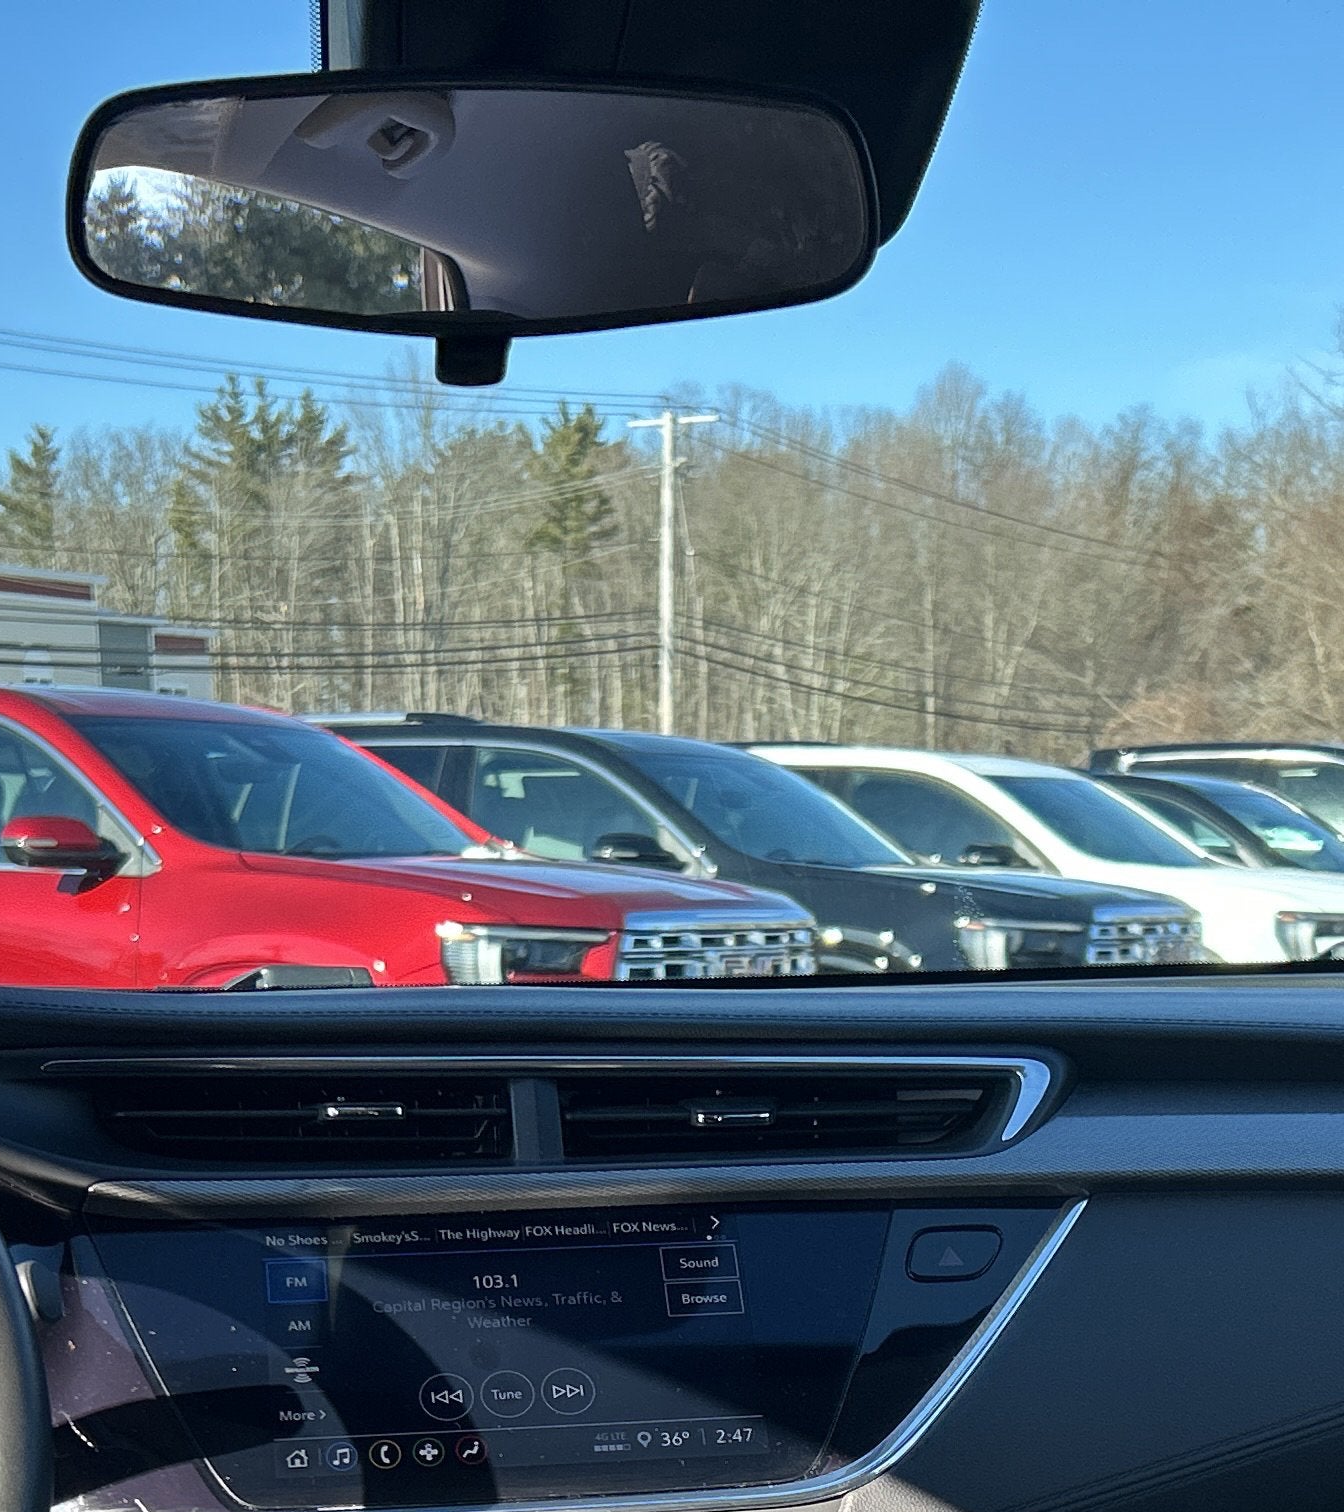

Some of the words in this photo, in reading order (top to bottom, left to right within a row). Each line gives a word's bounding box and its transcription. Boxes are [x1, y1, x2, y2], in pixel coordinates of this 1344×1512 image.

[438, 1228, 463, 1241] The
[466, 1226, 521, 1242] Highway
[524, 1224, 553, 1237] FOX
[612, 1221, 641, 1234] FOX
[265, 1235, 285, 1247] No
[288, 1234, 328, 1247] Shoes
[678, 1256, 720, 1269] Sound
[285, 1276, 308, 1288] FM
[472, 1273, 520, 1290] 103.1
[372, 1296, 427, 1315] Capital
[430, 1295, 498, 1315] Region's
[500, 1294, 549, 1309] News,
[552, 1291, 607, 1306] Traffic,
[611, 1290, 623, 1304] &
[680, 1292, 728, 1305] Browse
[287, 1319, 312, 1332] AM
[466, 1315, 533, 1330] Weather
[490, 1388, 524, 1401] Tune
[278, 1409, 316, 1422] More
[594, 1432, 610, 1442] 4G
[610, 1430, 627, 1442] LTE
[715, 1427, 754, 1445] 2:47
